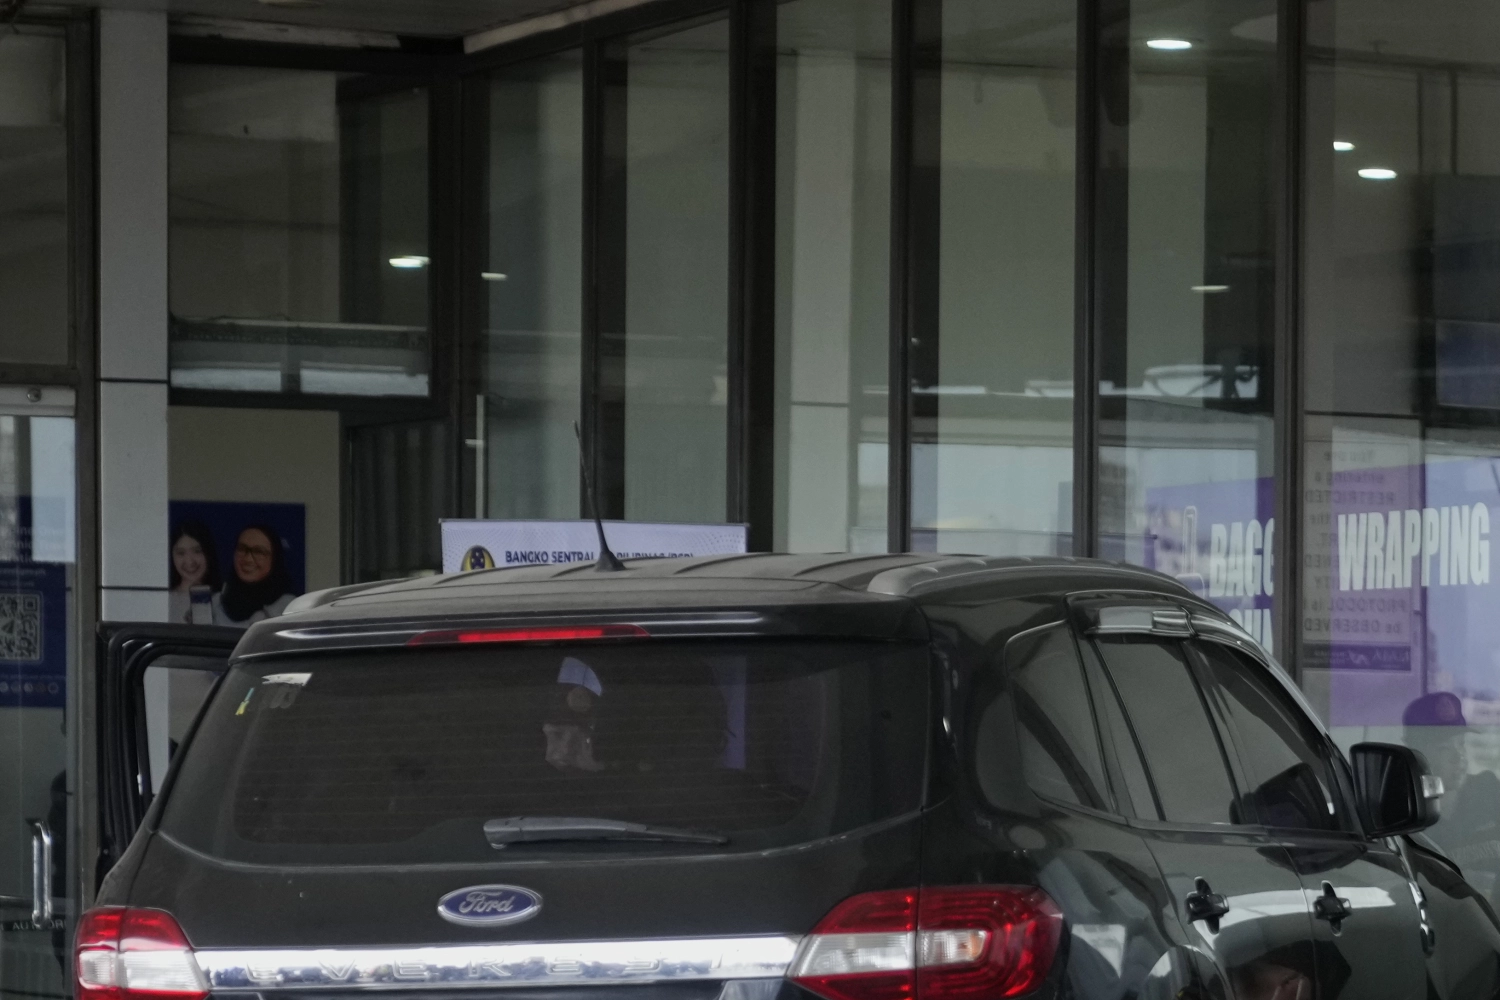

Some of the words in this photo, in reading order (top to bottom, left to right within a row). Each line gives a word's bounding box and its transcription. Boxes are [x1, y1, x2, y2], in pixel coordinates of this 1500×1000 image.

[505, 551, 548, 563] BANGKO
[1337, 502, 1490, 591] WRAPPING
[458, 891, 516, 913] Ford
